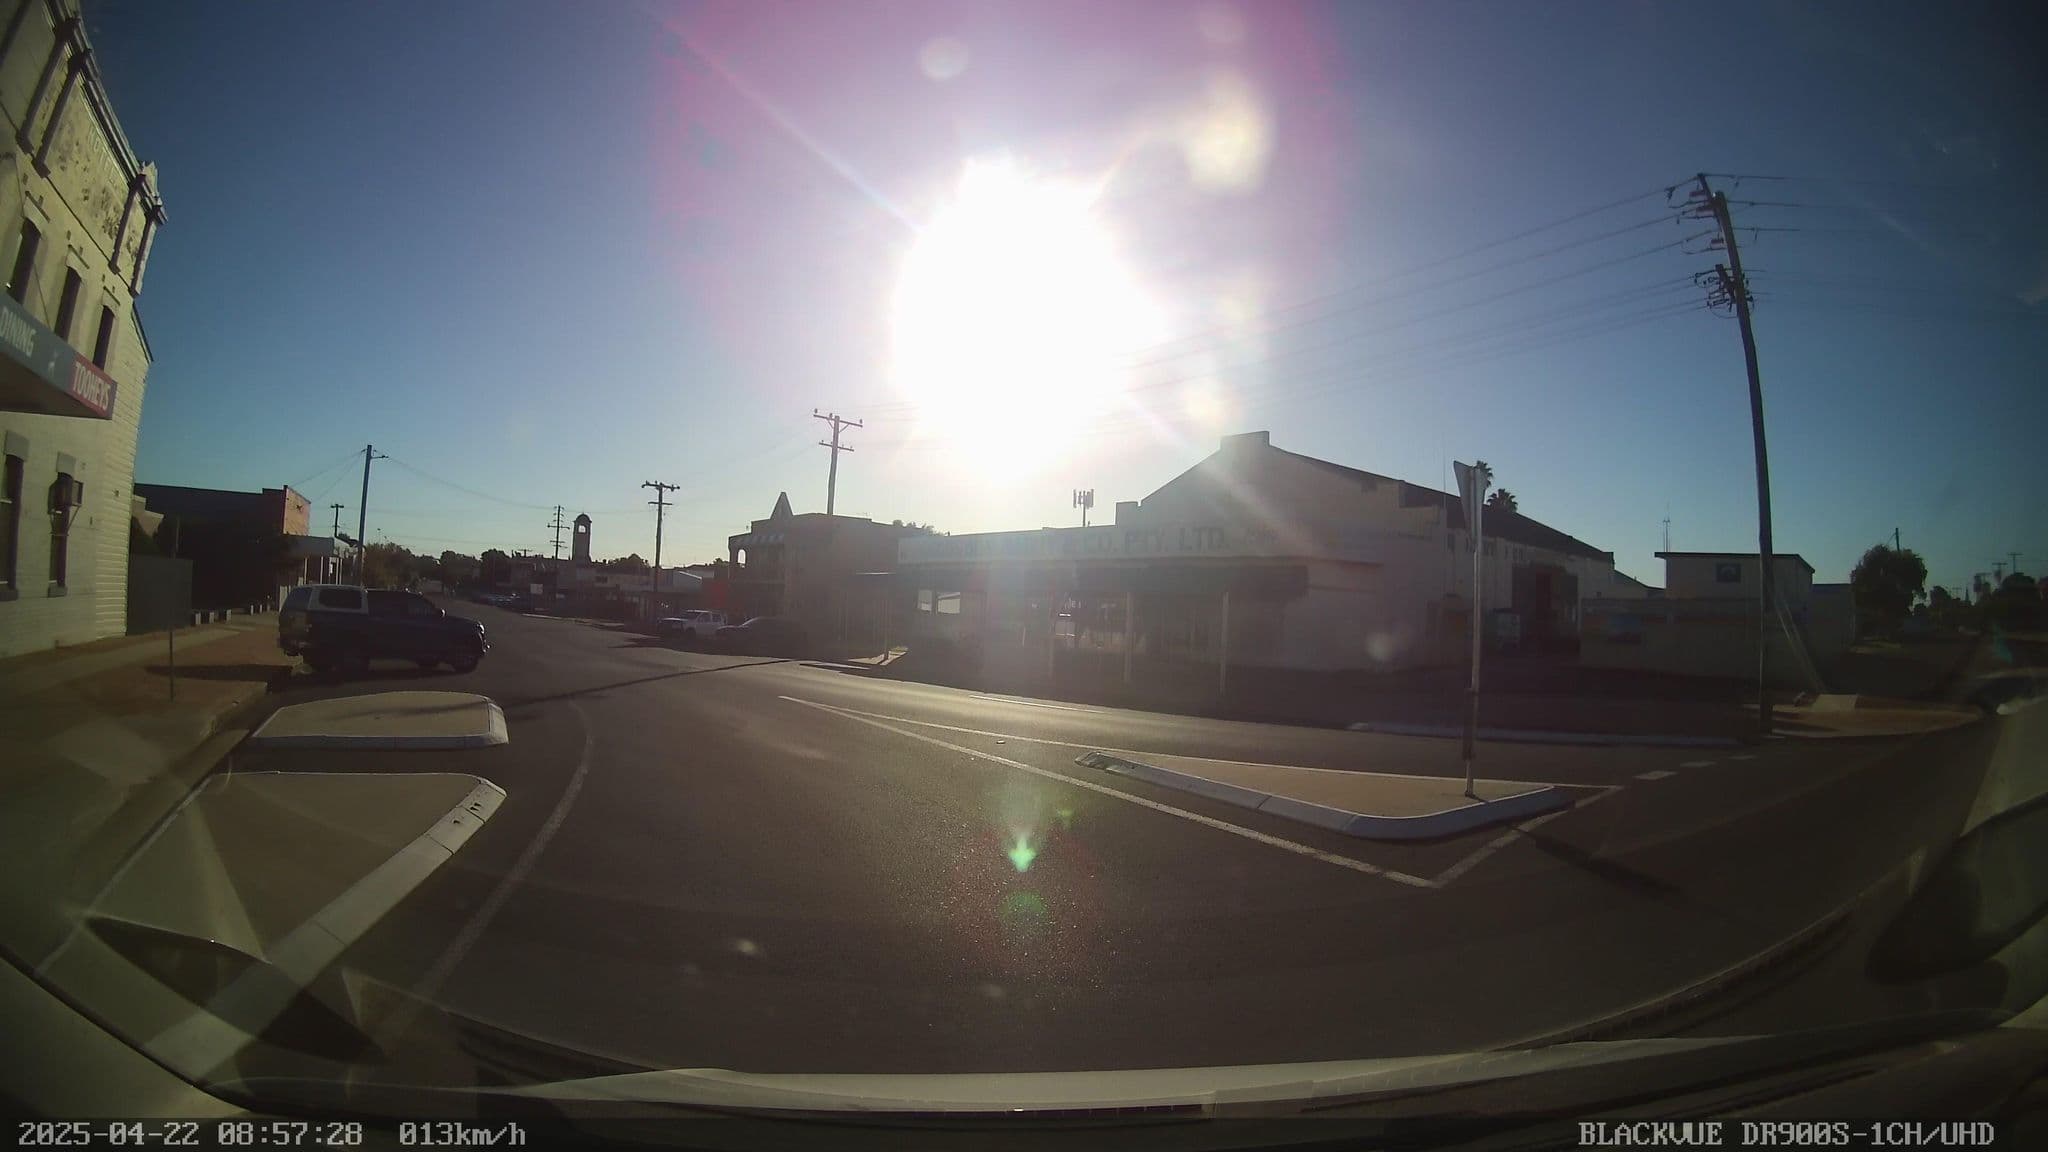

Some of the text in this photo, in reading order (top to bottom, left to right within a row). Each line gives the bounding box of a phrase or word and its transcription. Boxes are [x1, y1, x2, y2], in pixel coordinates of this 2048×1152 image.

[0, 306, 37, 358] DINING
[73, 361, 112, 411] TOOHEYS
[1124, 528, 1168, 552] PTY.
[1178, 525, 1230, 550] LTD.
